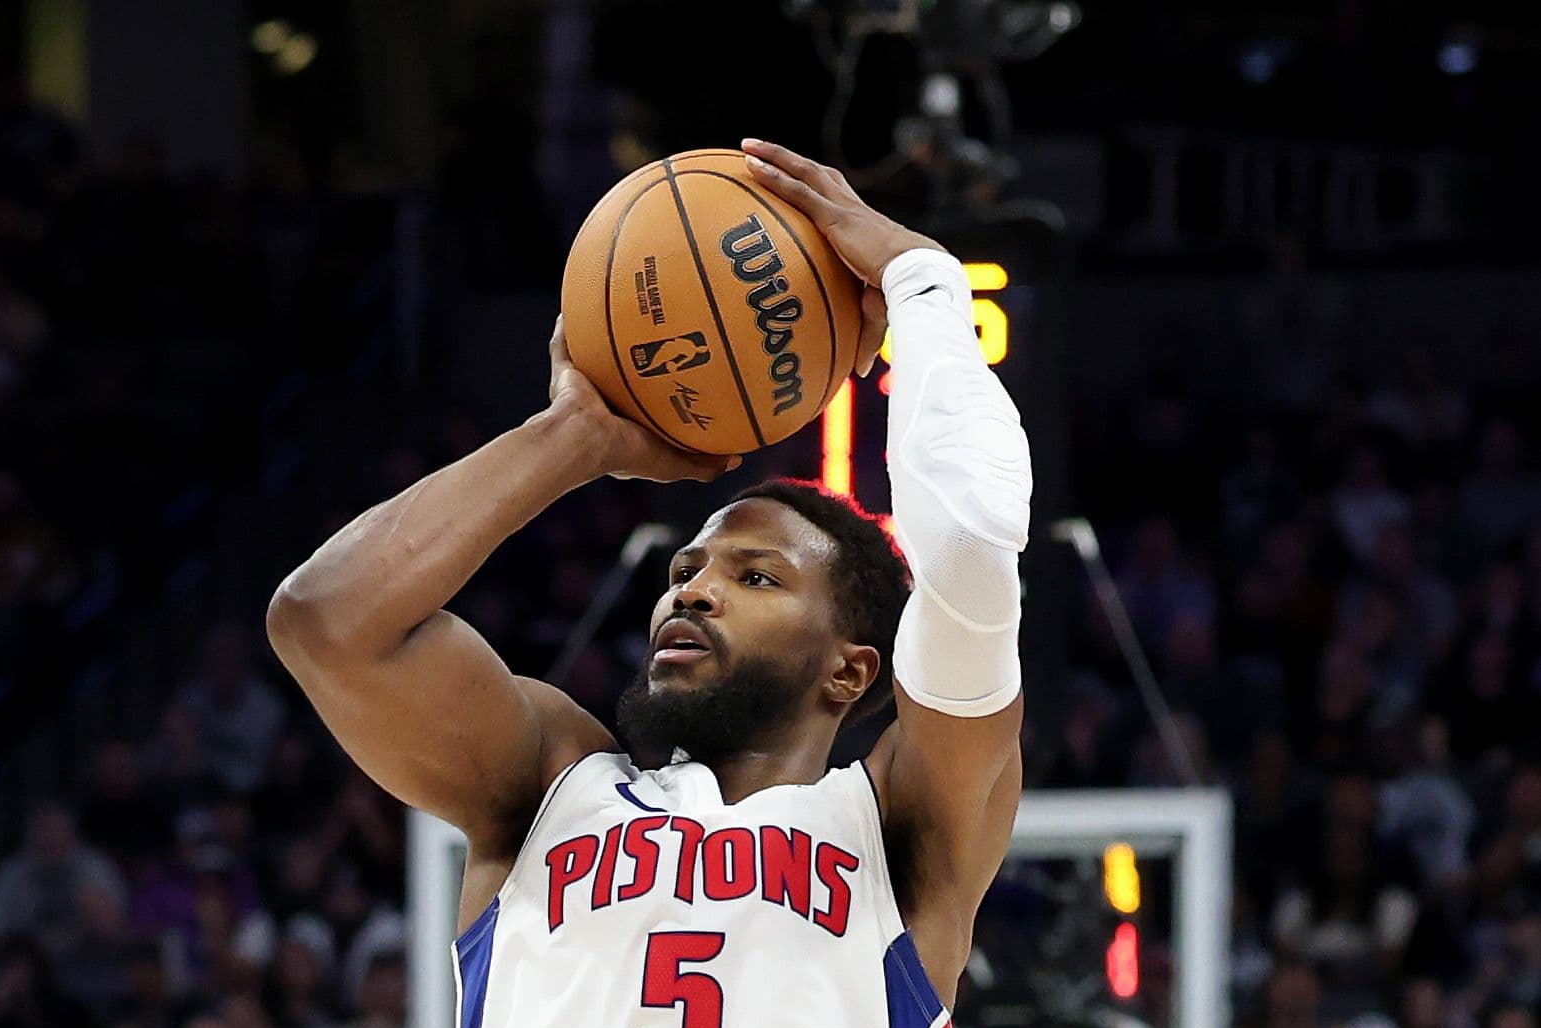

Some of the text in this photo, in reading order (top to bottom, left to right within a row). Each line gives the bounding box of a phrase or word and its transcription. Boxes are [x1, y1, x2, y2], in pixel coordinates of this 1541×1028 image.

[651, 308, 666, 326] BALL
[721, 213, 804, 416] Wilson
[545, 815, 860, 938] PISTONS
